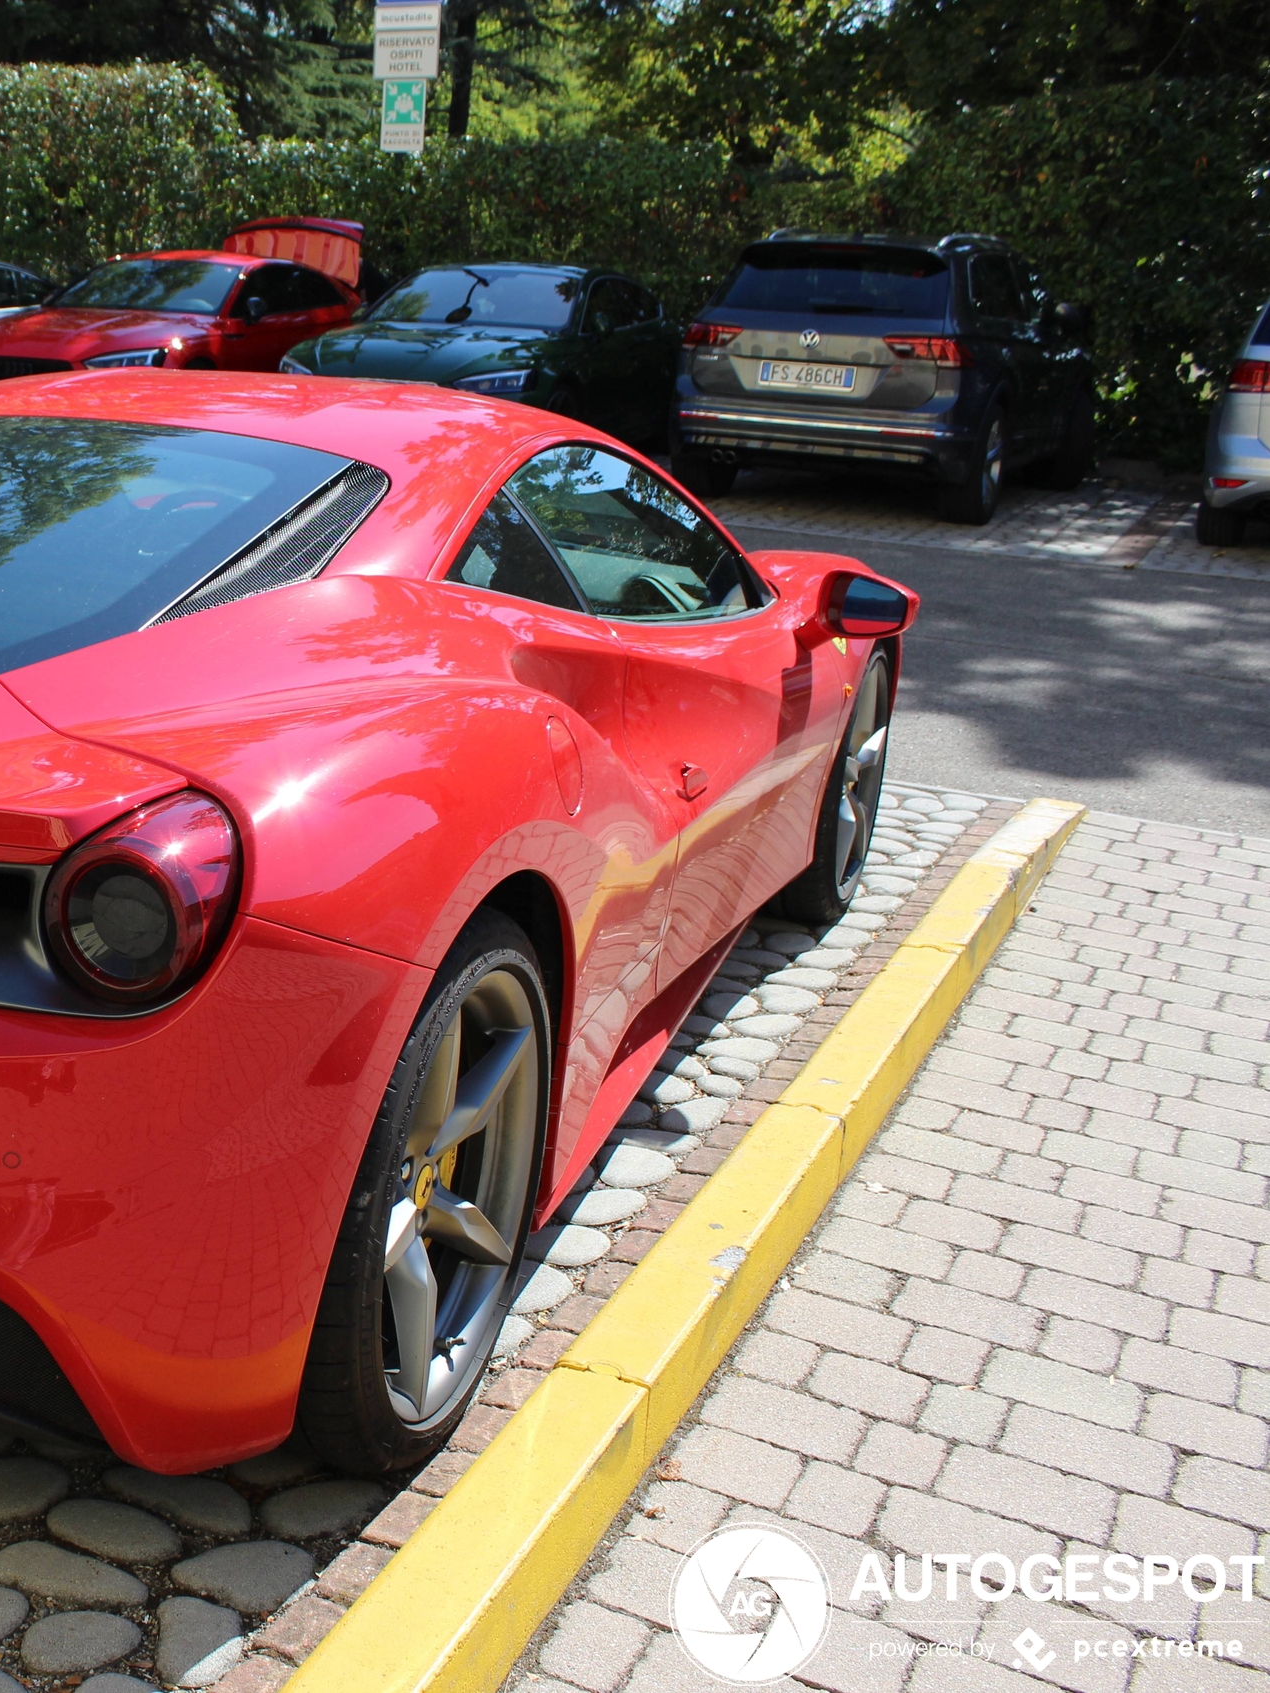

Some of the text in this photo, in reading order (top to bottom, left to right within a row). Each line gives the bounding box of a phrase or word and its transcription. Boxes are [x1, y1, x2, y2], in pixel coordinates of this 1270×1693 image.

[379, 36, 435, 46] RISERVATO
[390, 49, 423, 59] OSPITI
[389, 61, 422, 71] HOTEL
[771, 363, 845, 386] FS 486CH
